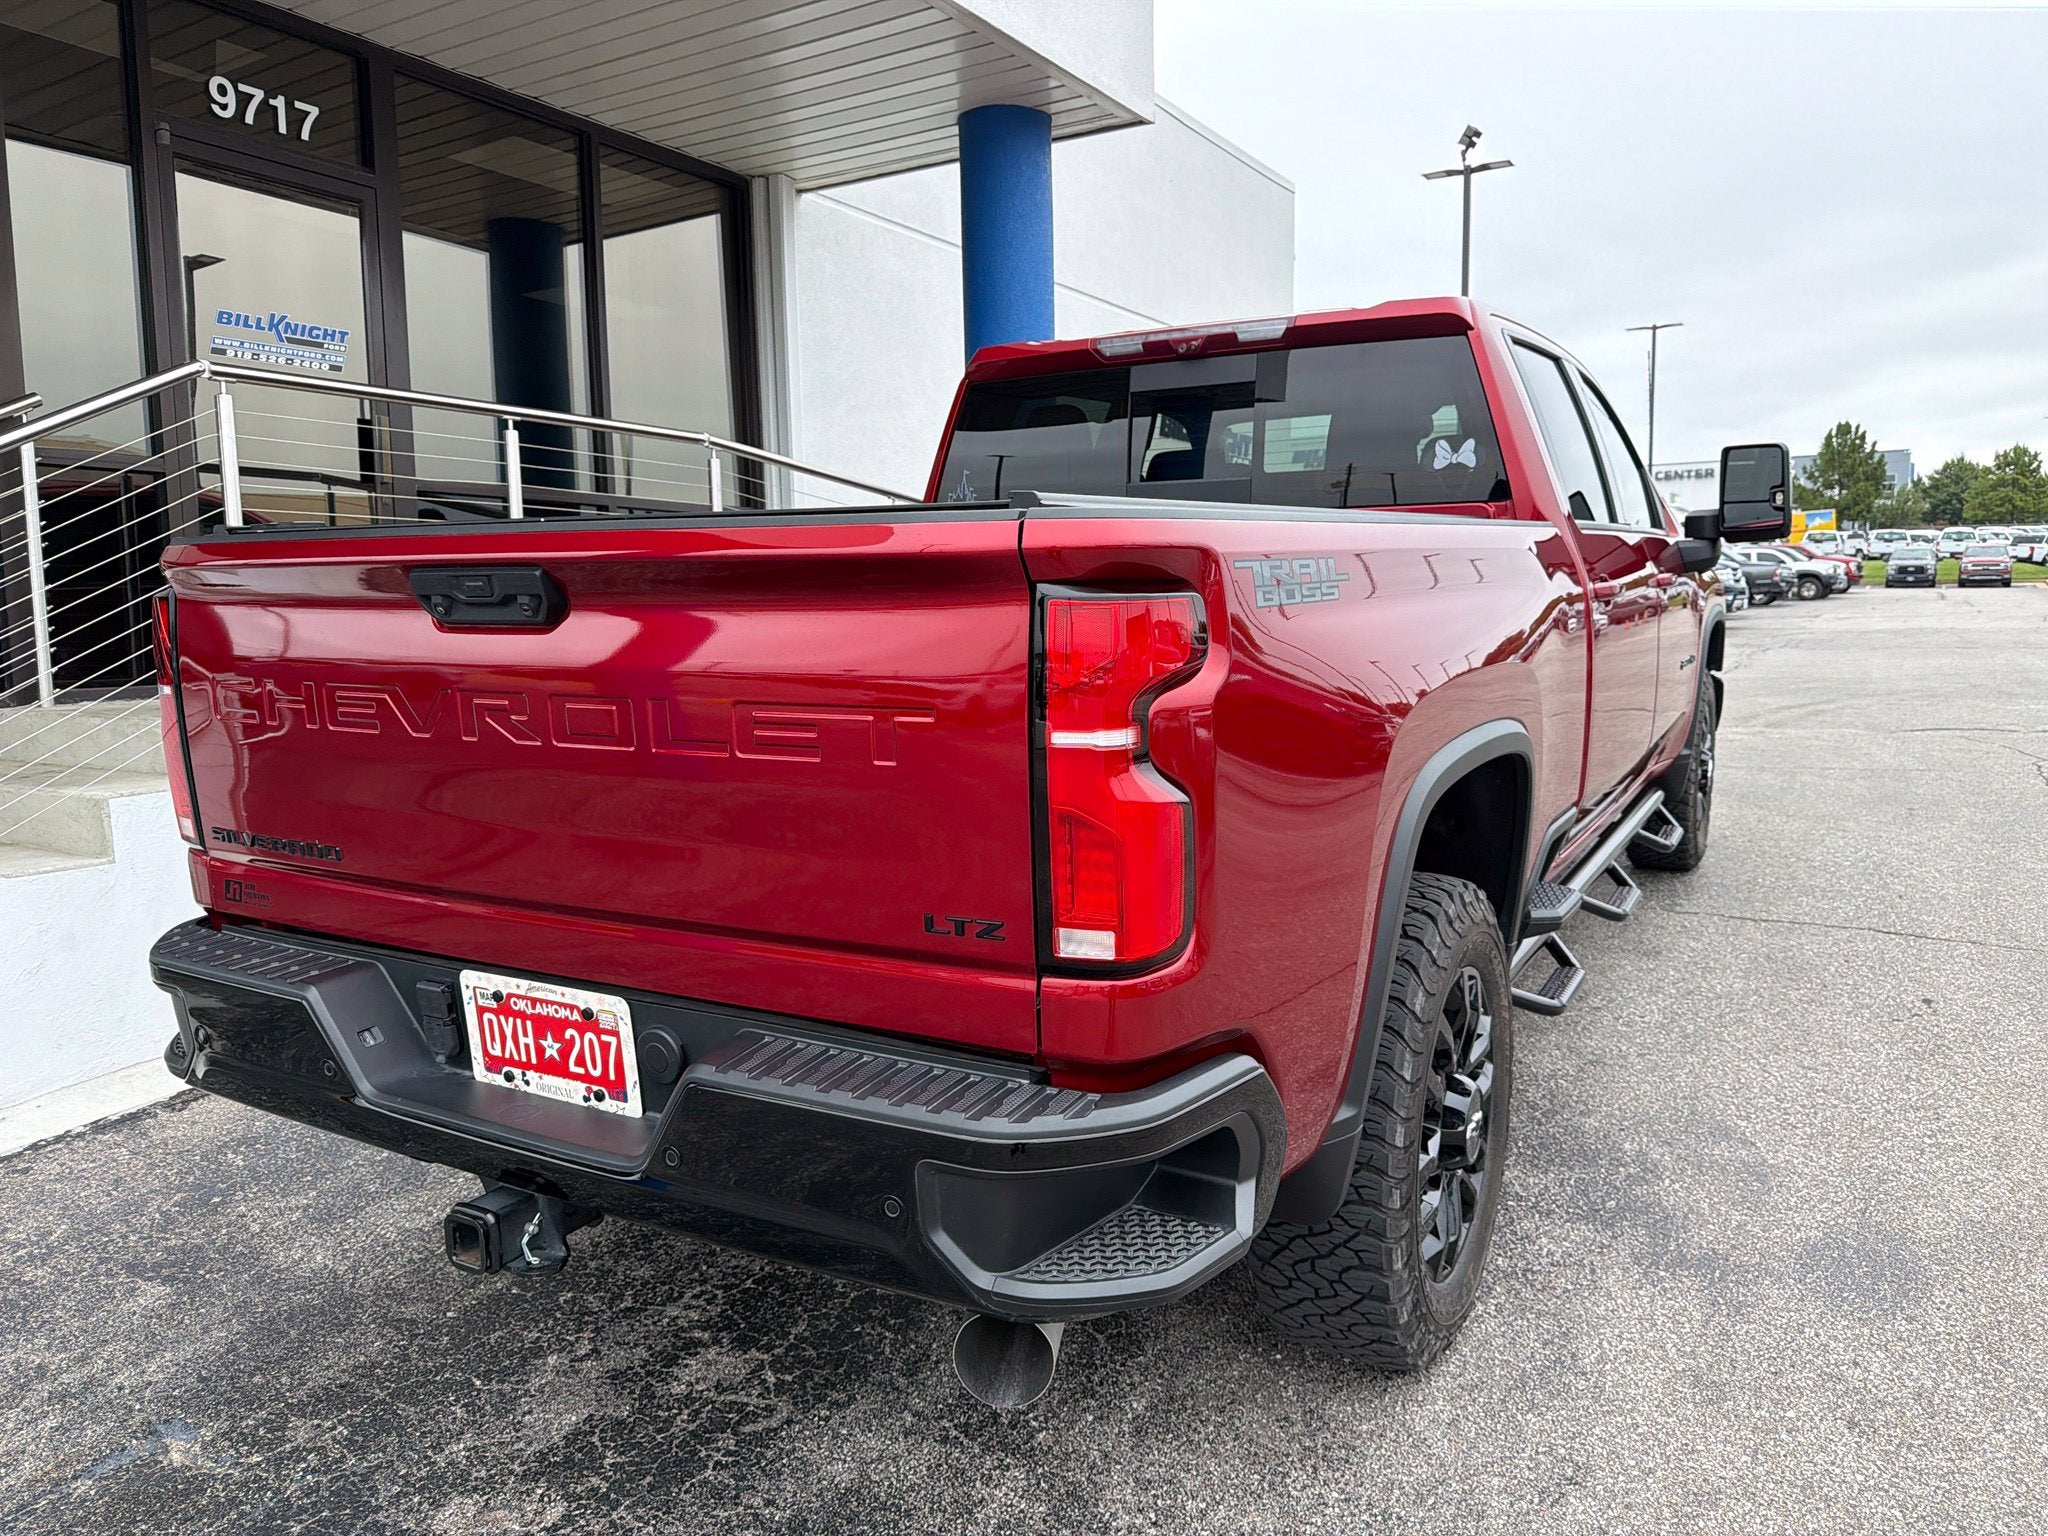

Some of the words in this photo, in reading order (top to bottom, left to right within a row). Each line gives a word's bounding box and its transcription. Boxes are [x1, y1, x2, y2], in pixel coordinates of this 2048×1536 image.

[208, 75, 320, 141] 9717
[214, 338, 344, 363] WWW.BILLKNIGHTFORD.COM
[226, 349, 330, 370] 918-526-2400
[323, 343, 346, 352] FORD
[1655, 468, 1715, 481] CENTER
[1234, 557, 1350, 586] TRAIL
[1255, 582, 1340, 609] BOSS
[212, 674, 936, 766] CHEVROLET
[211, 826, 343, 861] SILVERADO
[923, 914, 1005, 941] LTZ
[525, 983, 558, 996] American
[510, 997, 582, 1022] OKLAHOMA
[483, 1012, 537, 1064] QXH
[564, 1028, 617, 1081] 207
[536, 1081, 574, 1099] ORIGINAL
